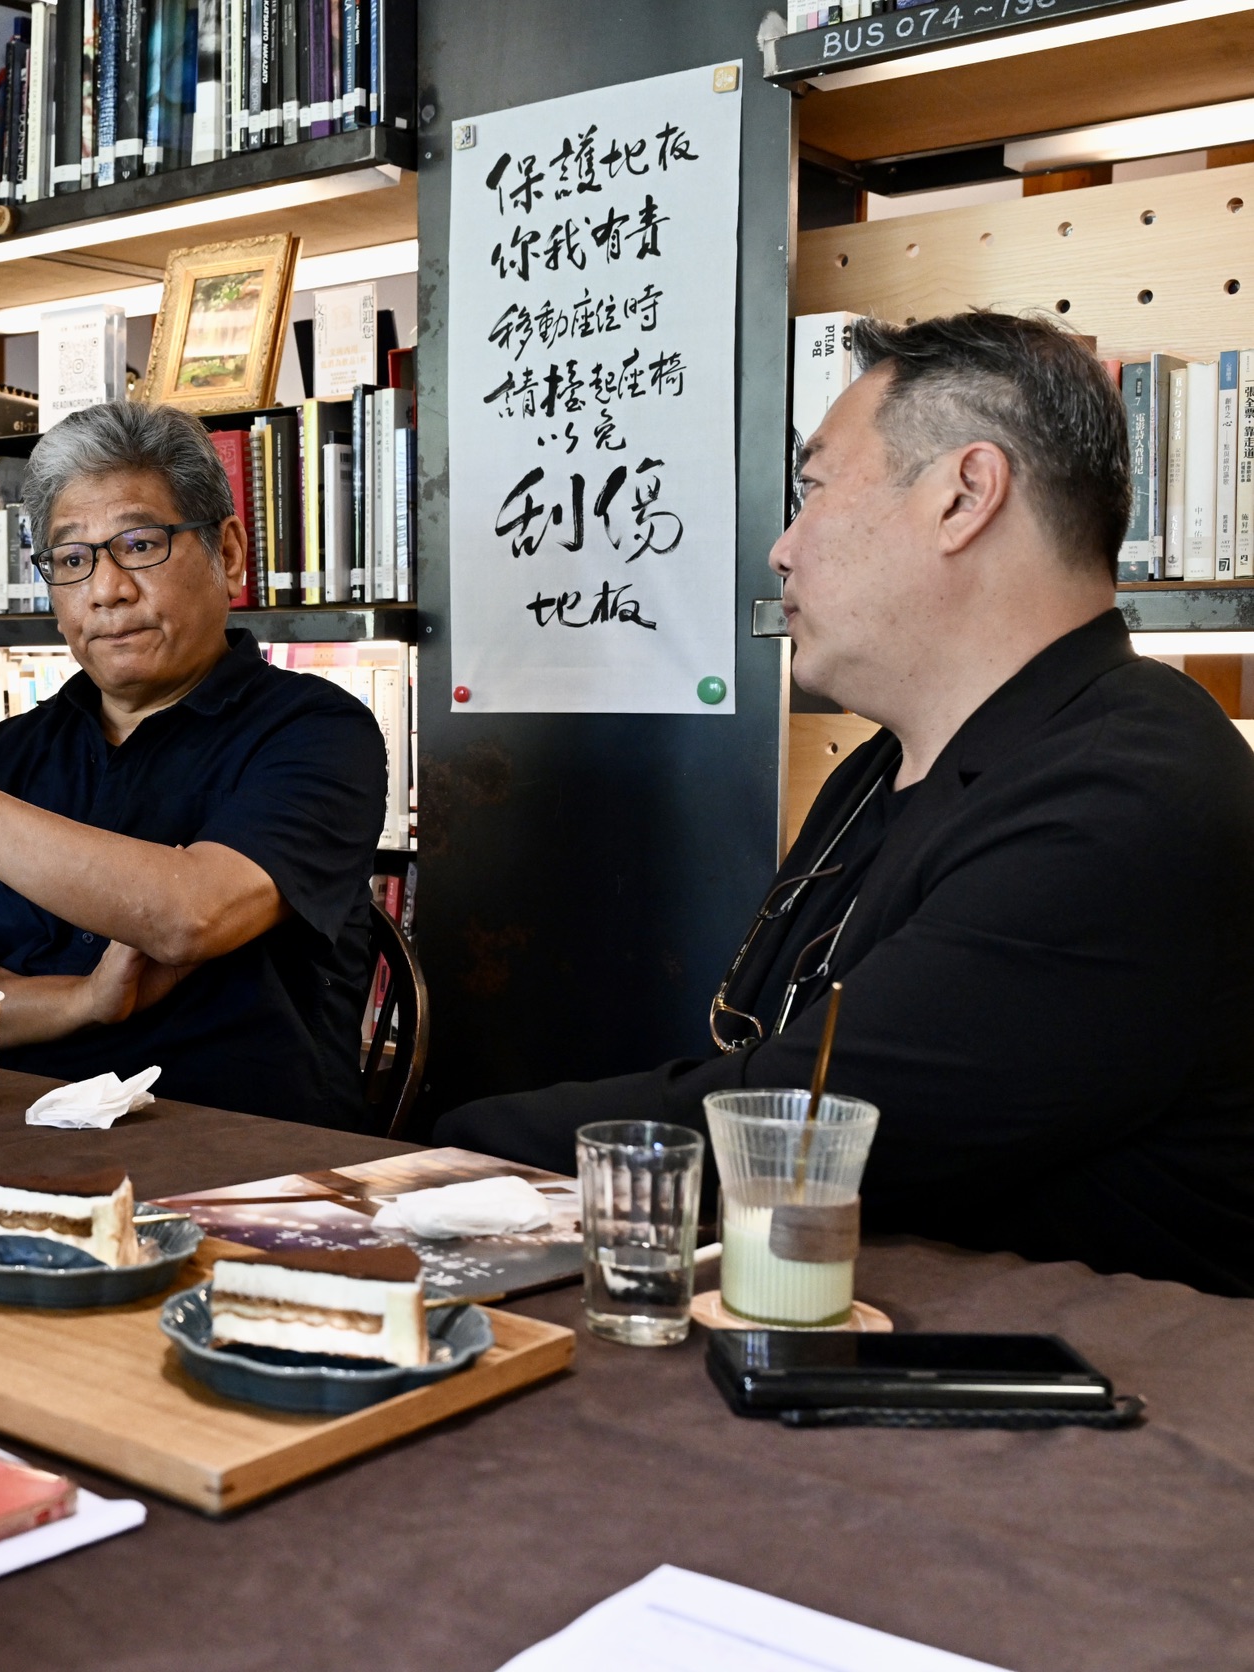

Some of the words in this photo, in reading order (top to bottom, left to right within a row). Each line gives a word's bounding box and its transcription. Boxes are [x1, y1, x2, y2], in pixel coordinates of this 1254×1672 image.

[822, 22, 885, 58] BUS
[486, 122, 699, 215] 保護地板
[492, 195, 670, 281] 你我有責
[488, 284, 663, 361] 移動座位時
[825, 324, 836, 357] Wild
[812, 340, 823, 358] Be
[1135, 397, 1141, 406] 7
[537, 408, 626, 454] 以免
[1134, 413, 1146, 475] 電影詩人費里尼
[496, 457, 684, 564] 刮傷
[526, 580, 659, 631] 地板
